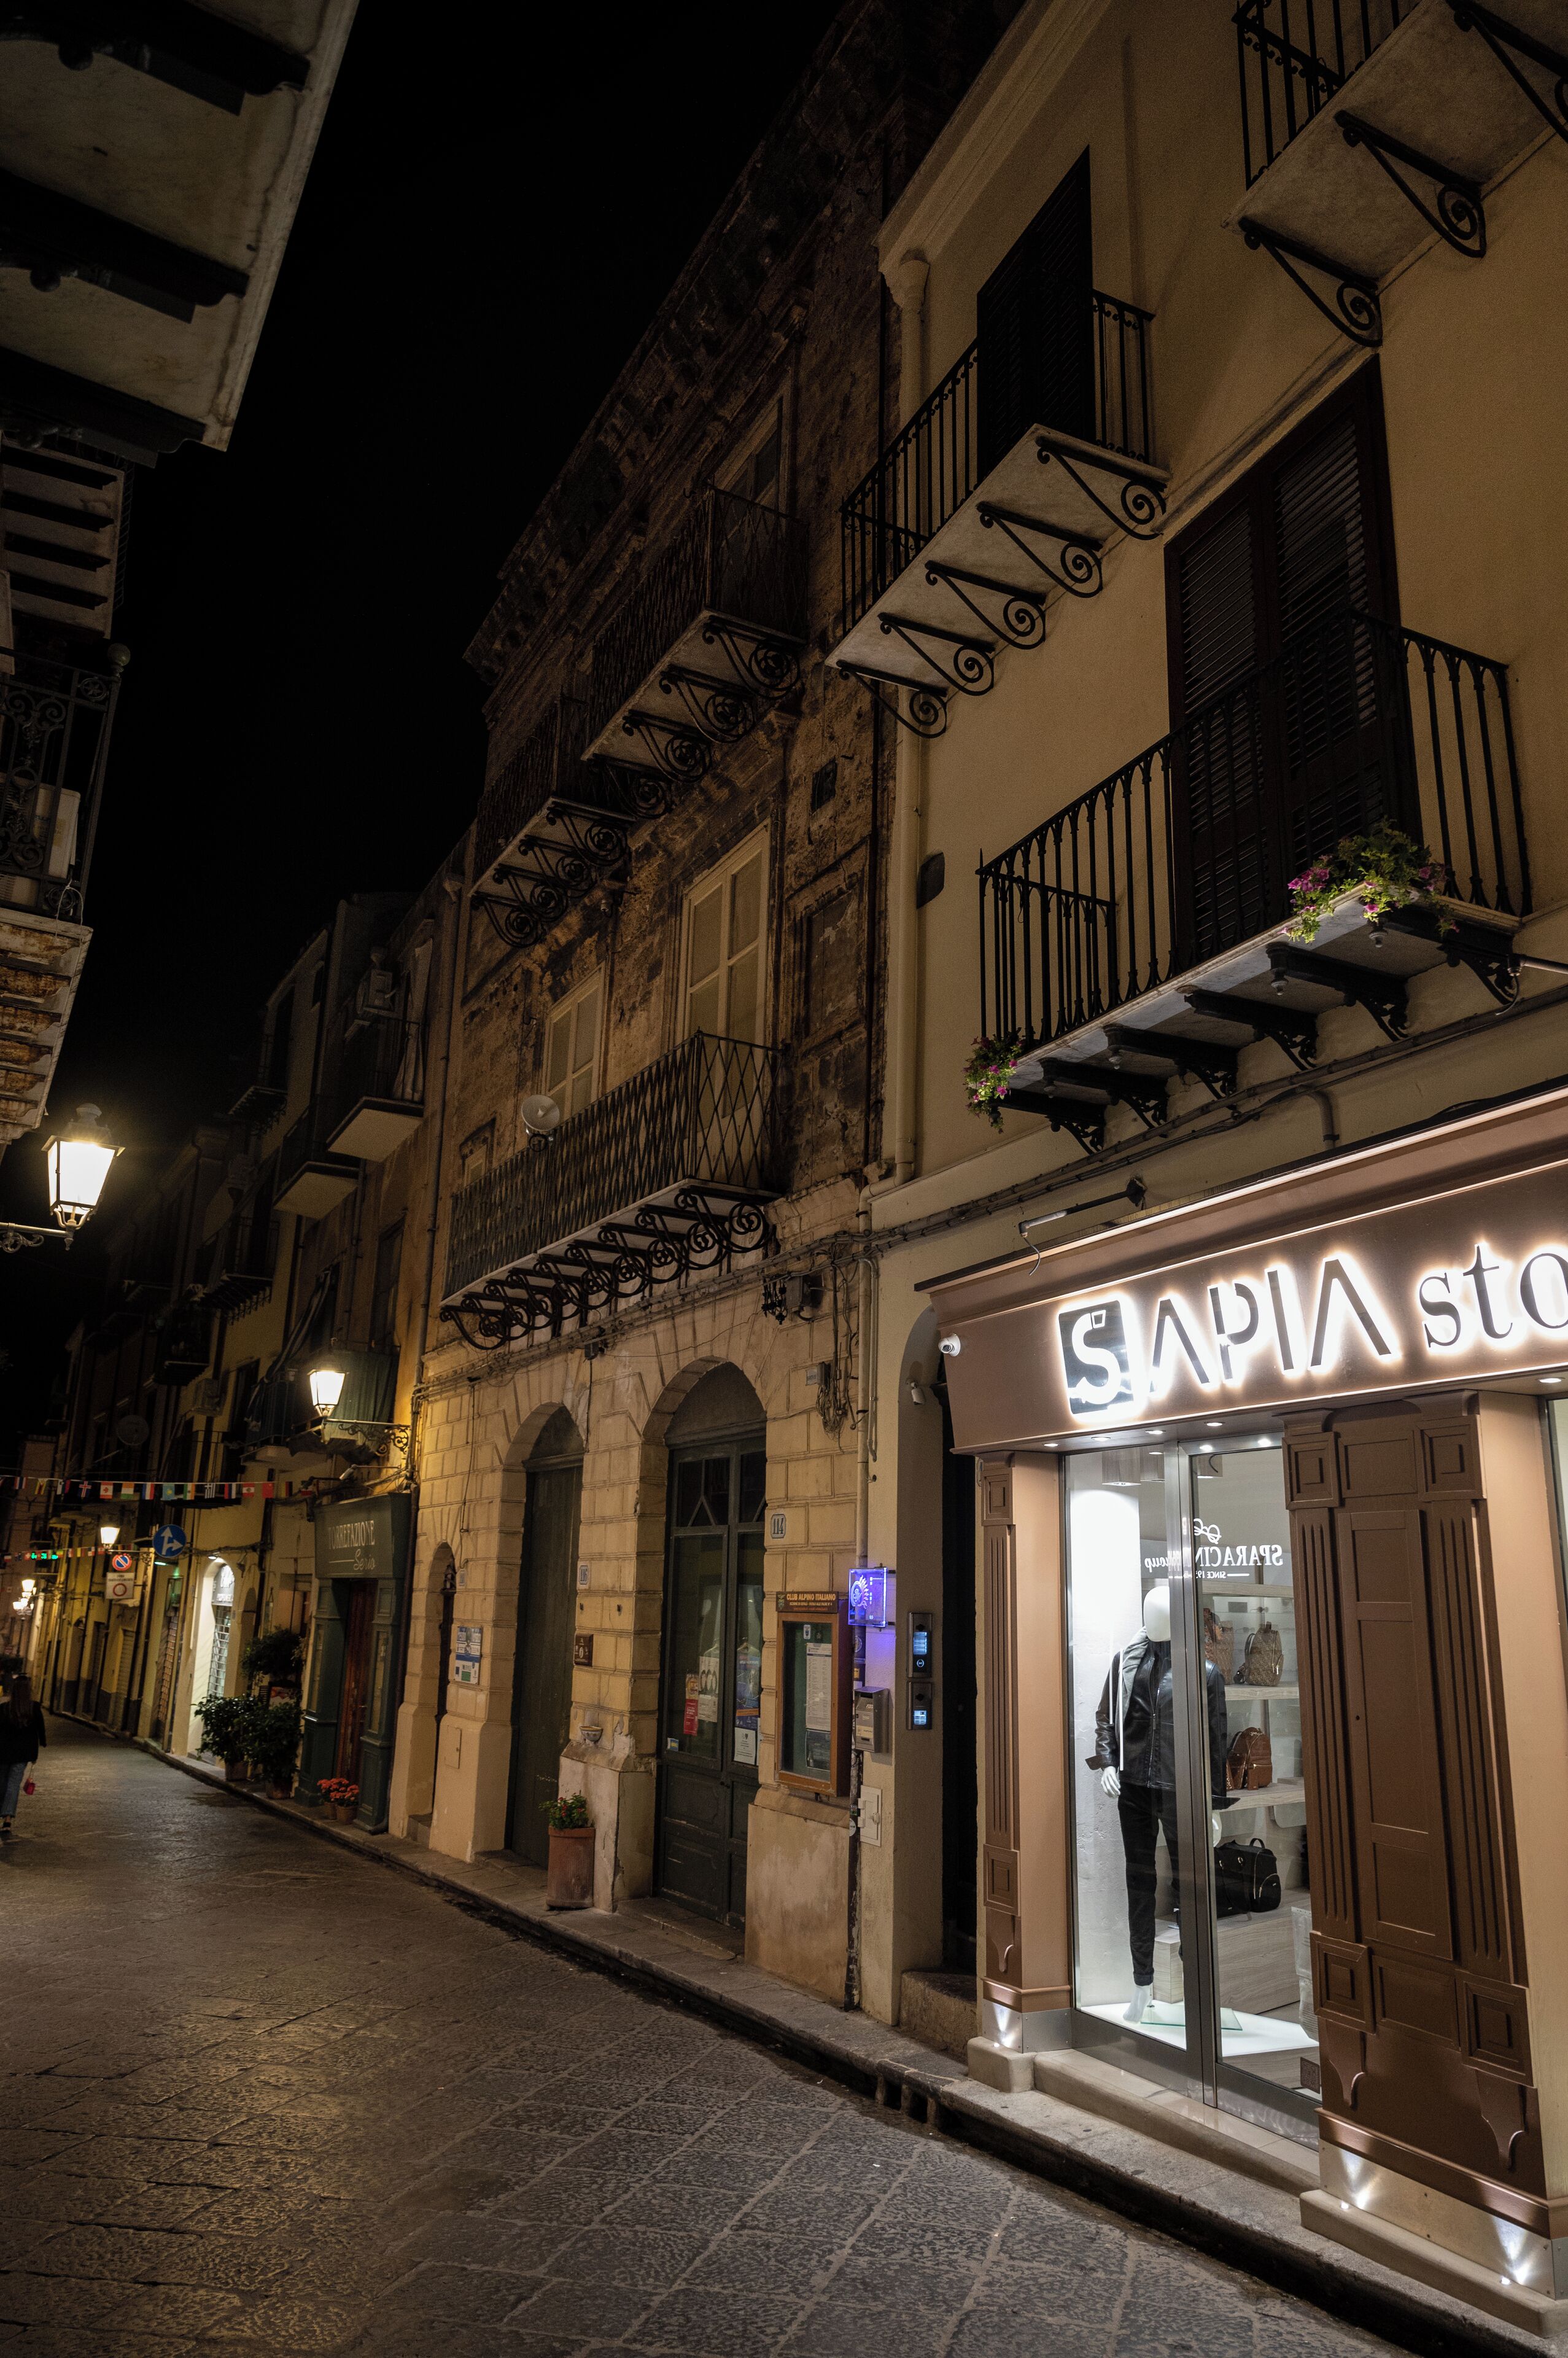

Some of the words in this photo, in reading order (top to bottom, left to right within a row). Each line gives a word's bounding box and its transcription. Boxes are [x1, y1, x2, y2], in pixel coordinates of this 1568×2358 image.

[1419, 1243, 1568, 1350] sto
[328, 1520, 375, 1549] TORREFAZIONE
[772, 1517, 784, 1535] 114
[353, 1548, 376, 1570] Serio
